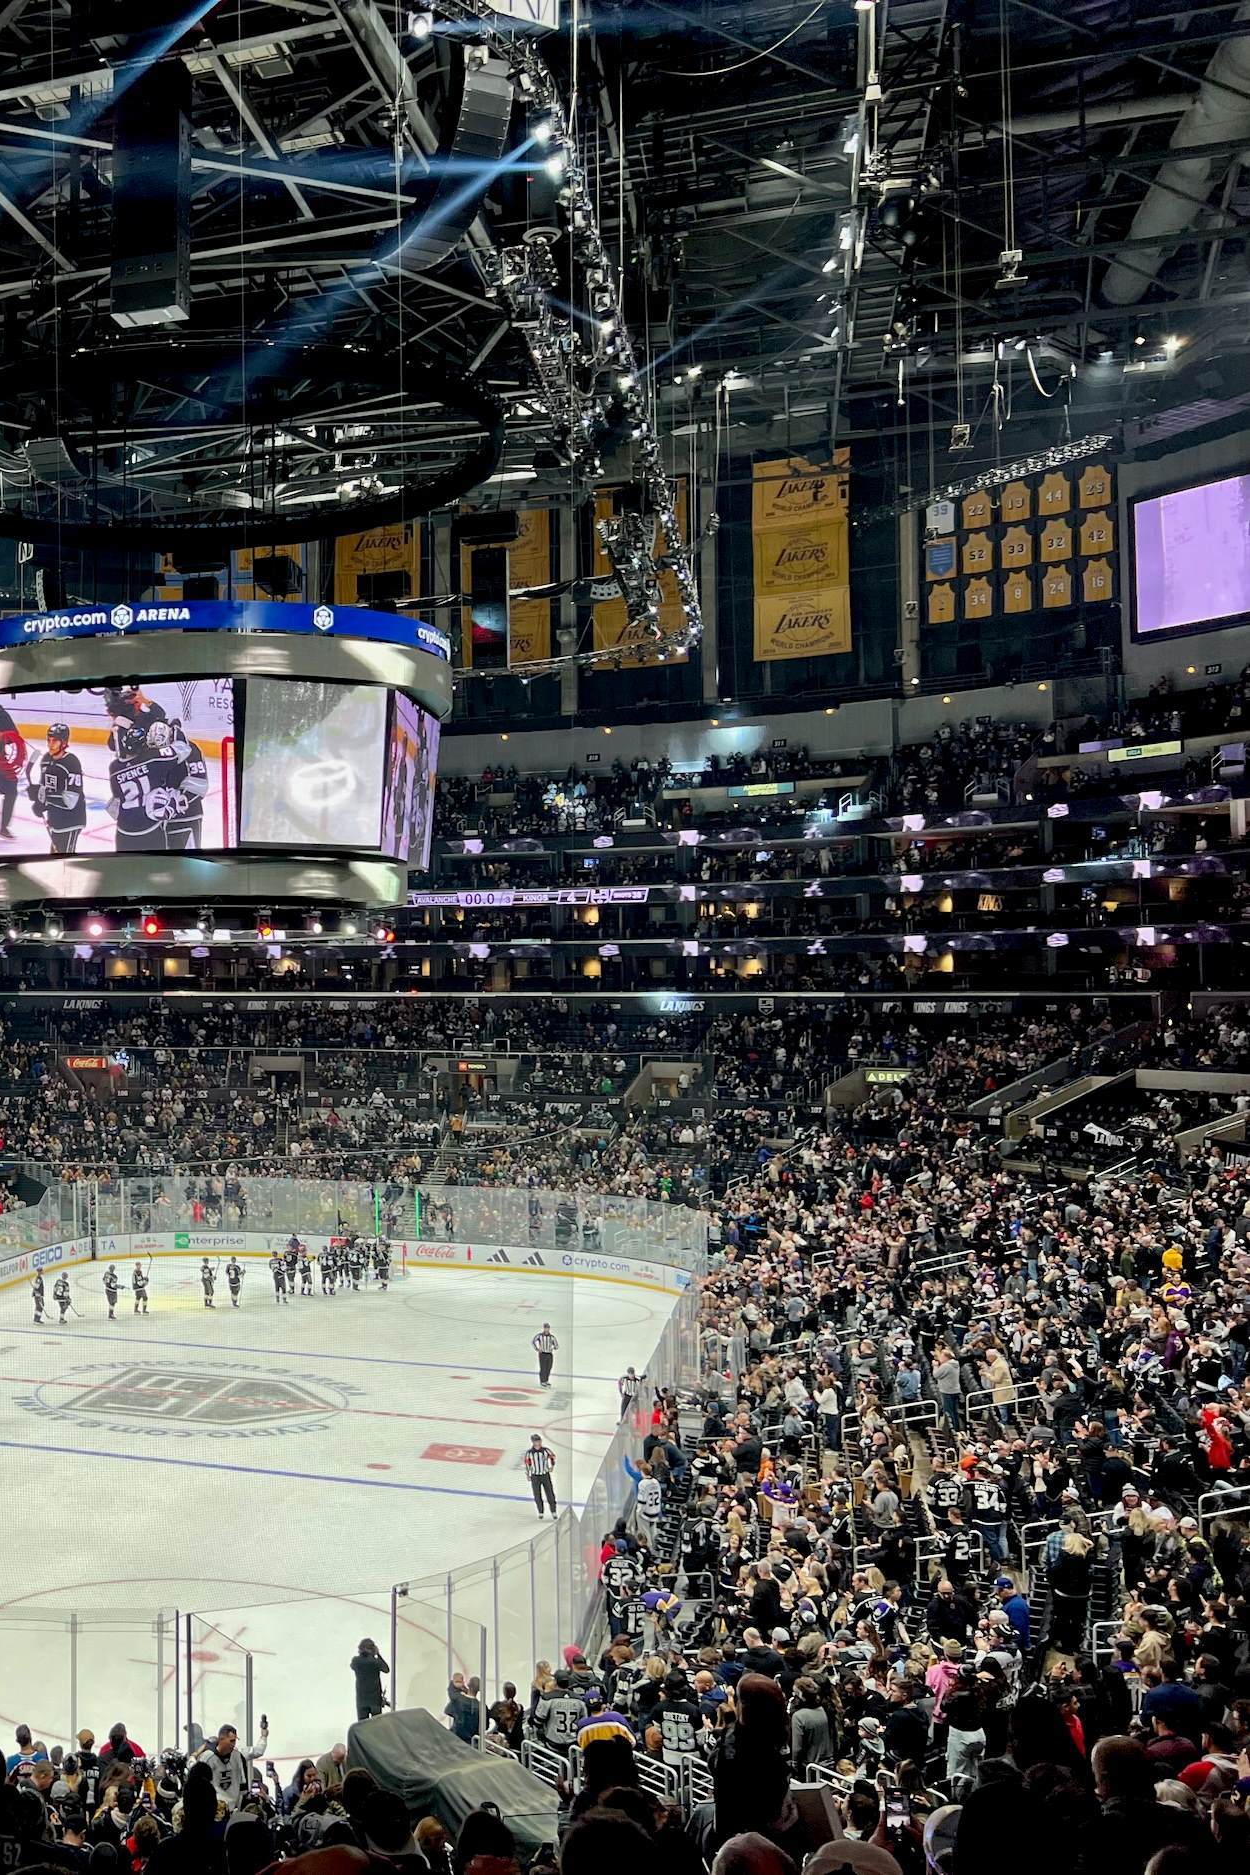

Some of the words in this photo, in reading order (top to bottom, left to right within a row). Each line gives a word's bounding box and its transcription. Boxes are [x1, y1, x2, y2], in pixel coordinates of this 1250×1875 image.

[1086, 481, 1104, 495] 25
[1045, 487, 1063, 503] 44
[968, 504, 984, 517] 22
[1048, 536, 1064, 549] 32
[1088, 530, 1104, 542] 42
[353, 535, 402, 552] LAKERS
[1008, 544, 1024, 555] 33
[774, 546, 828, 567] LAKERS
[969, 549, 984, 561] 52
[1049, 582, 1065, 595] 24
[1091, 577, 1105, 588] 16
[970, 594, 986, 606] 34
[1014, 588, 1023, 600] 8
[24, 612, 106, 633] crypto.com
[136, 607, 190, 622] ARENA
[774, 614, 832, 634] LAKERS
[116, 764, 150, 784] SPENCE
[416, 896, 457, 905] AVALANCHE
[464, 892, 495, 906] 00.0
[522, 893, 549, 903] KINGS
[566, 892, 577, 903] 4
[63, 1000, 76, 1010] LA
[75, 1000, 104, 1010] KINGS
[660, 1001, 676, 1011] LA
[674, 1000, 706, 1012] KINGS
[72, 1058, 100, 1069] Coca-Cola
[179, 1234, 245, 1247] enterprise
[32, 1245, 63, 1269] GEICO
[416, 1244, 456, 1258] Coca-Cola
[574, 1256, 630, 1272] crypto.com
[974, 1490, 1000, 1511] 34
[610, 1568, 634, 1587] 32
[556, 1711, 579, 1734] 32
[661, 1720, 696, 1751] 99
